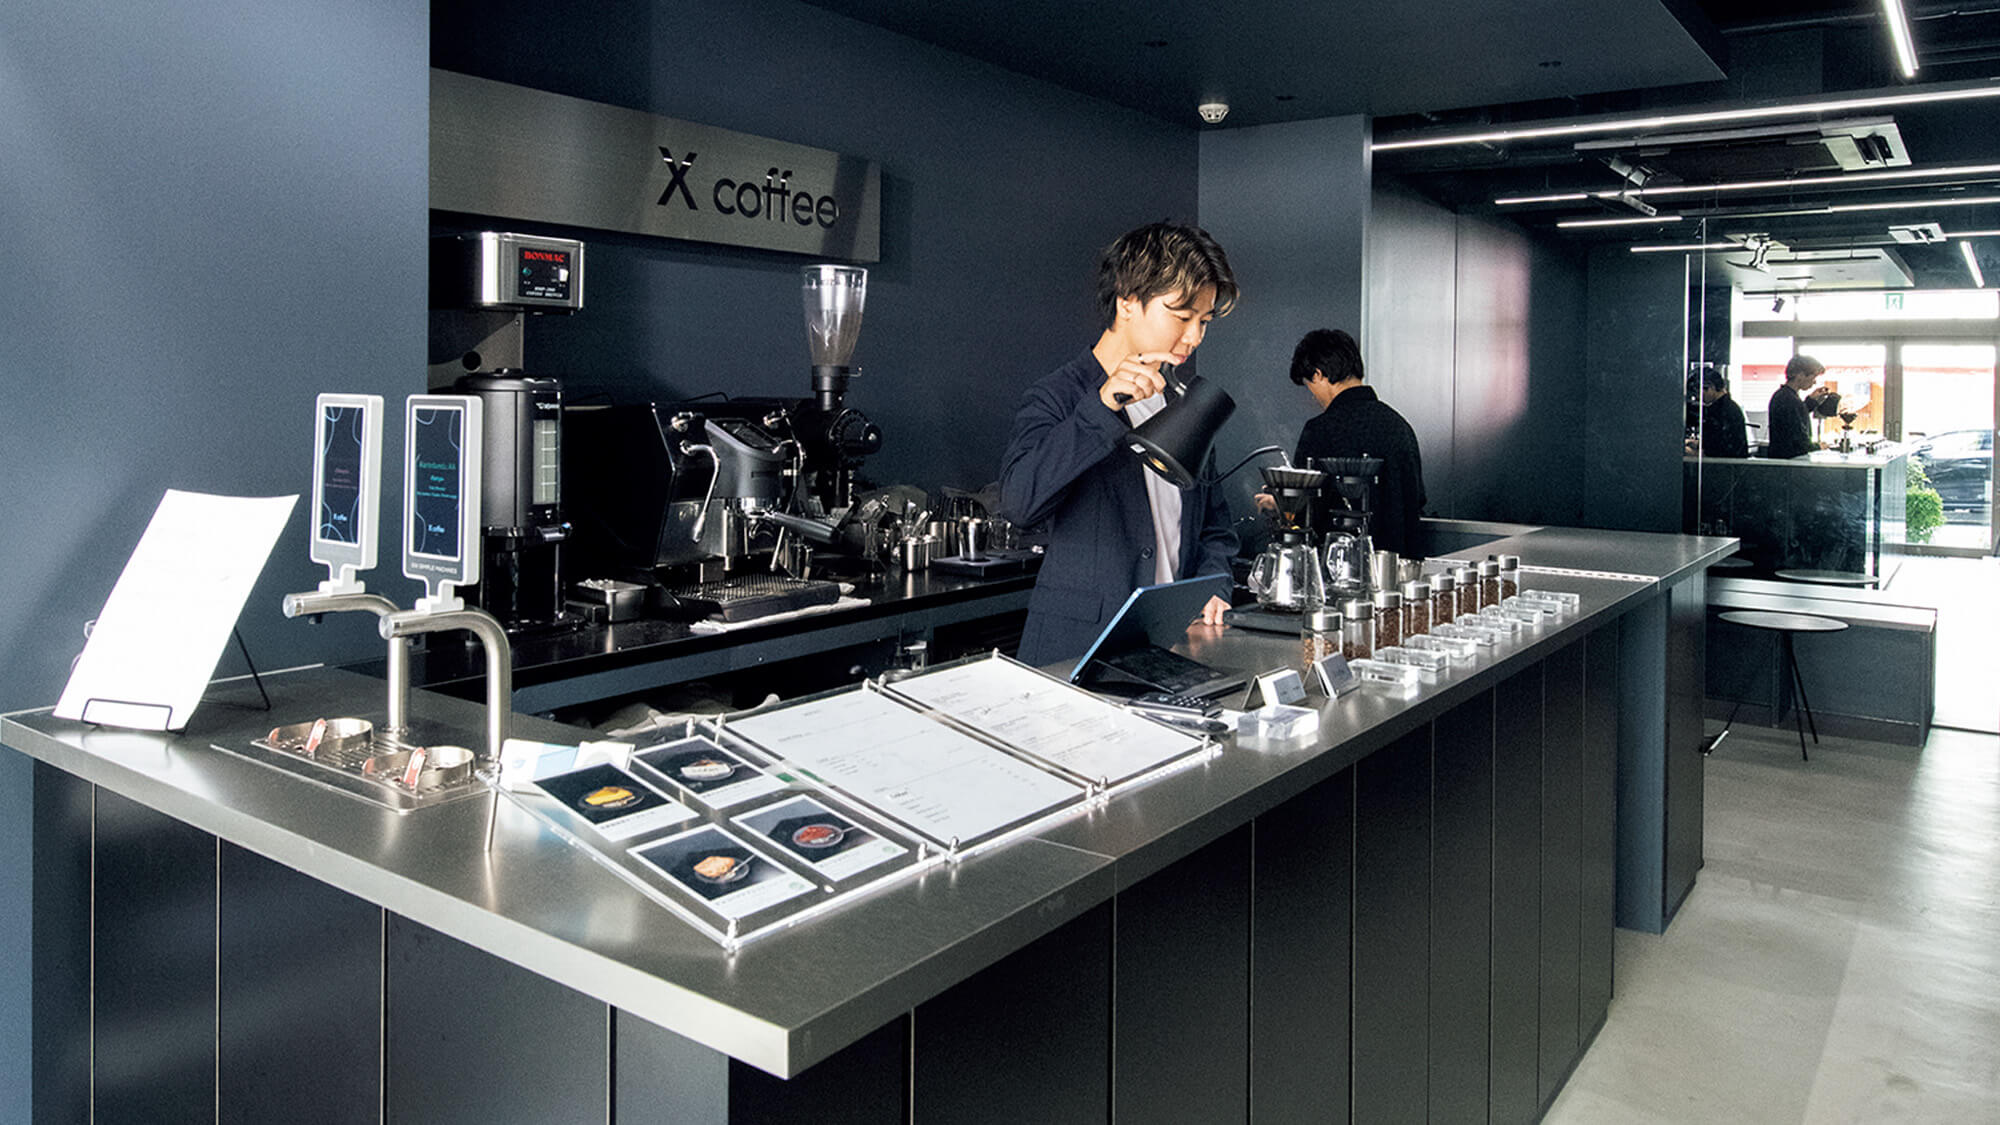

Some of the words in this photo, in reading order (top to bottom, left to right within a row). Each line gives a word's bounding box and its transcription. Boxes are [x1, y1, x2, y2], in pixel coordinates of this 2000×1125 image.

[657, 145, 698, 211] X
[713, 167, 839, 229] coffee
[524, 251, 565, 262] BONMAC
